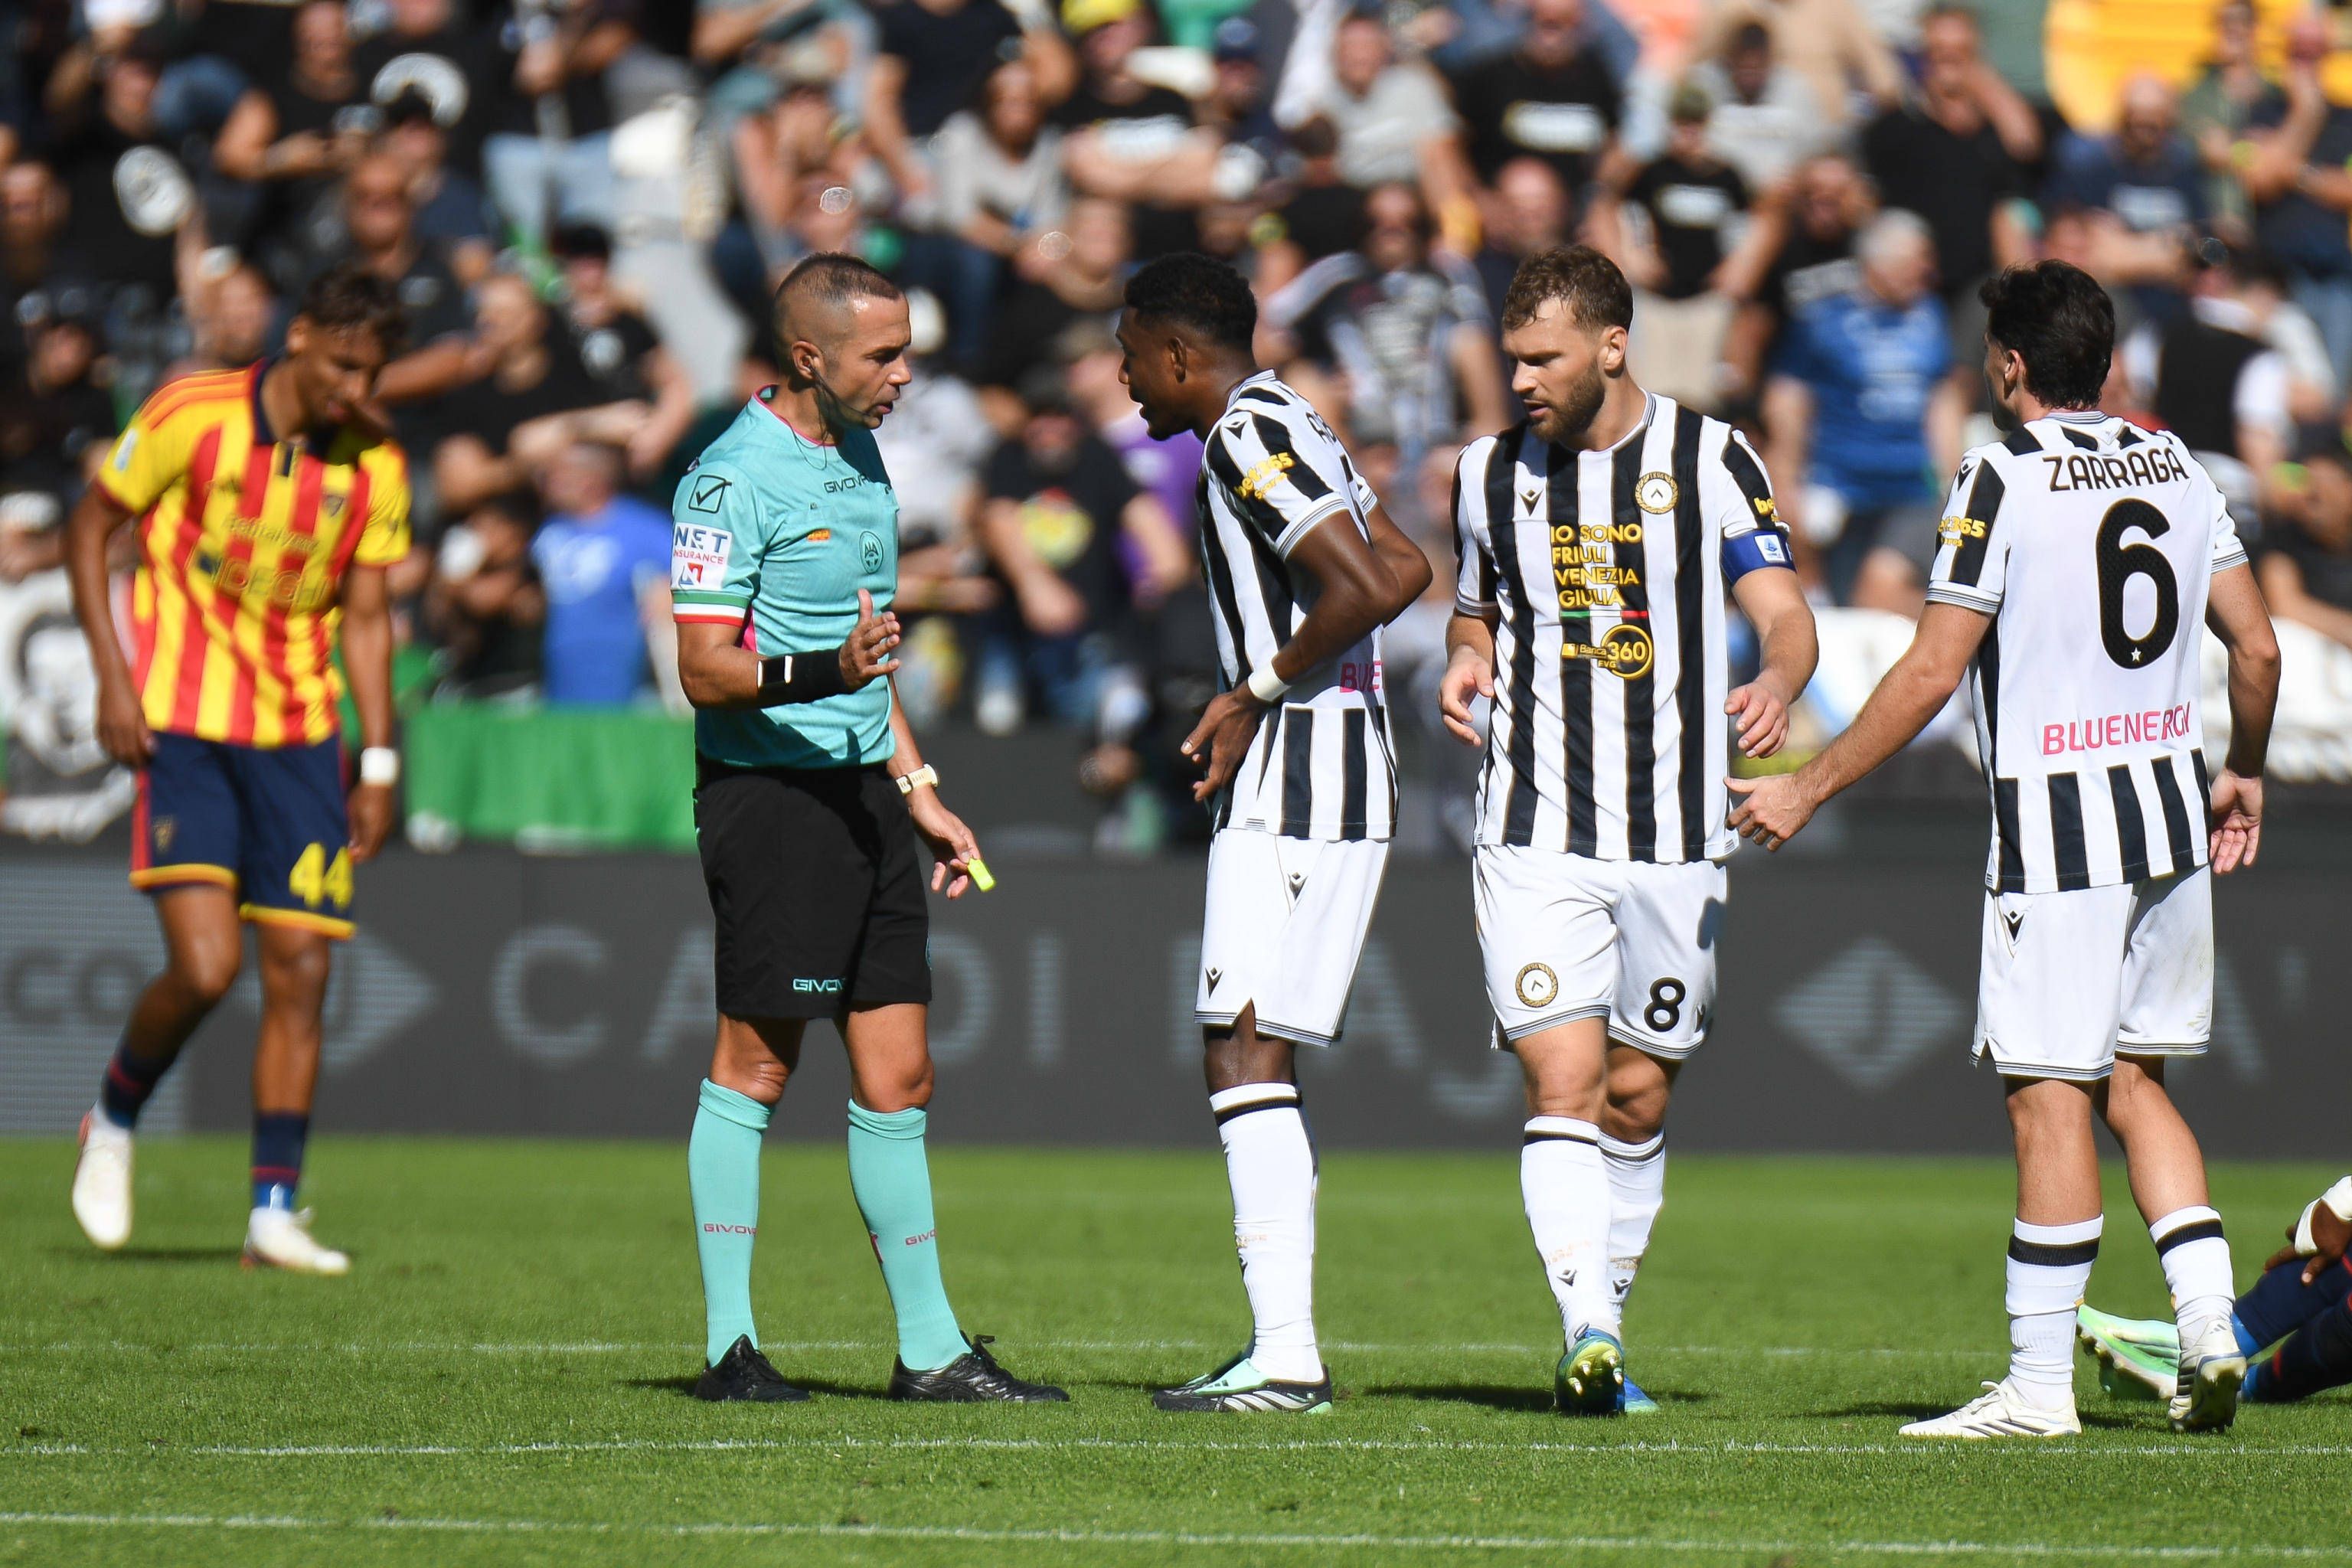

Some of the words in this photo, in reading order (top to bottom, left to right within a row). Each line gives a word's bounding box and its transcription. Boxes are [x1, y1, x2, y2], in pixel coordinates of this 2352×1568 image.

[2042, 447, 2190, 492] ZARRAGA
[674, 525, 728, 554] NET
[1550, 524, 1575, 544] IO
[1579, 523, 1643, 543] SONO
[1551, 545, 1607, 564] FRIULI
[1553, 567, 1641, 586] VENEZIA
[2096, 497, 2180, 670] 6
[1558, 587, 1626, 607] GIULIA
[1579, 643, 1607, 657] Banca
[1607, 641, 1646, 662] 360
[289, 841, 354, 912] 44
[1644, 976, 1686, 1033] 8
